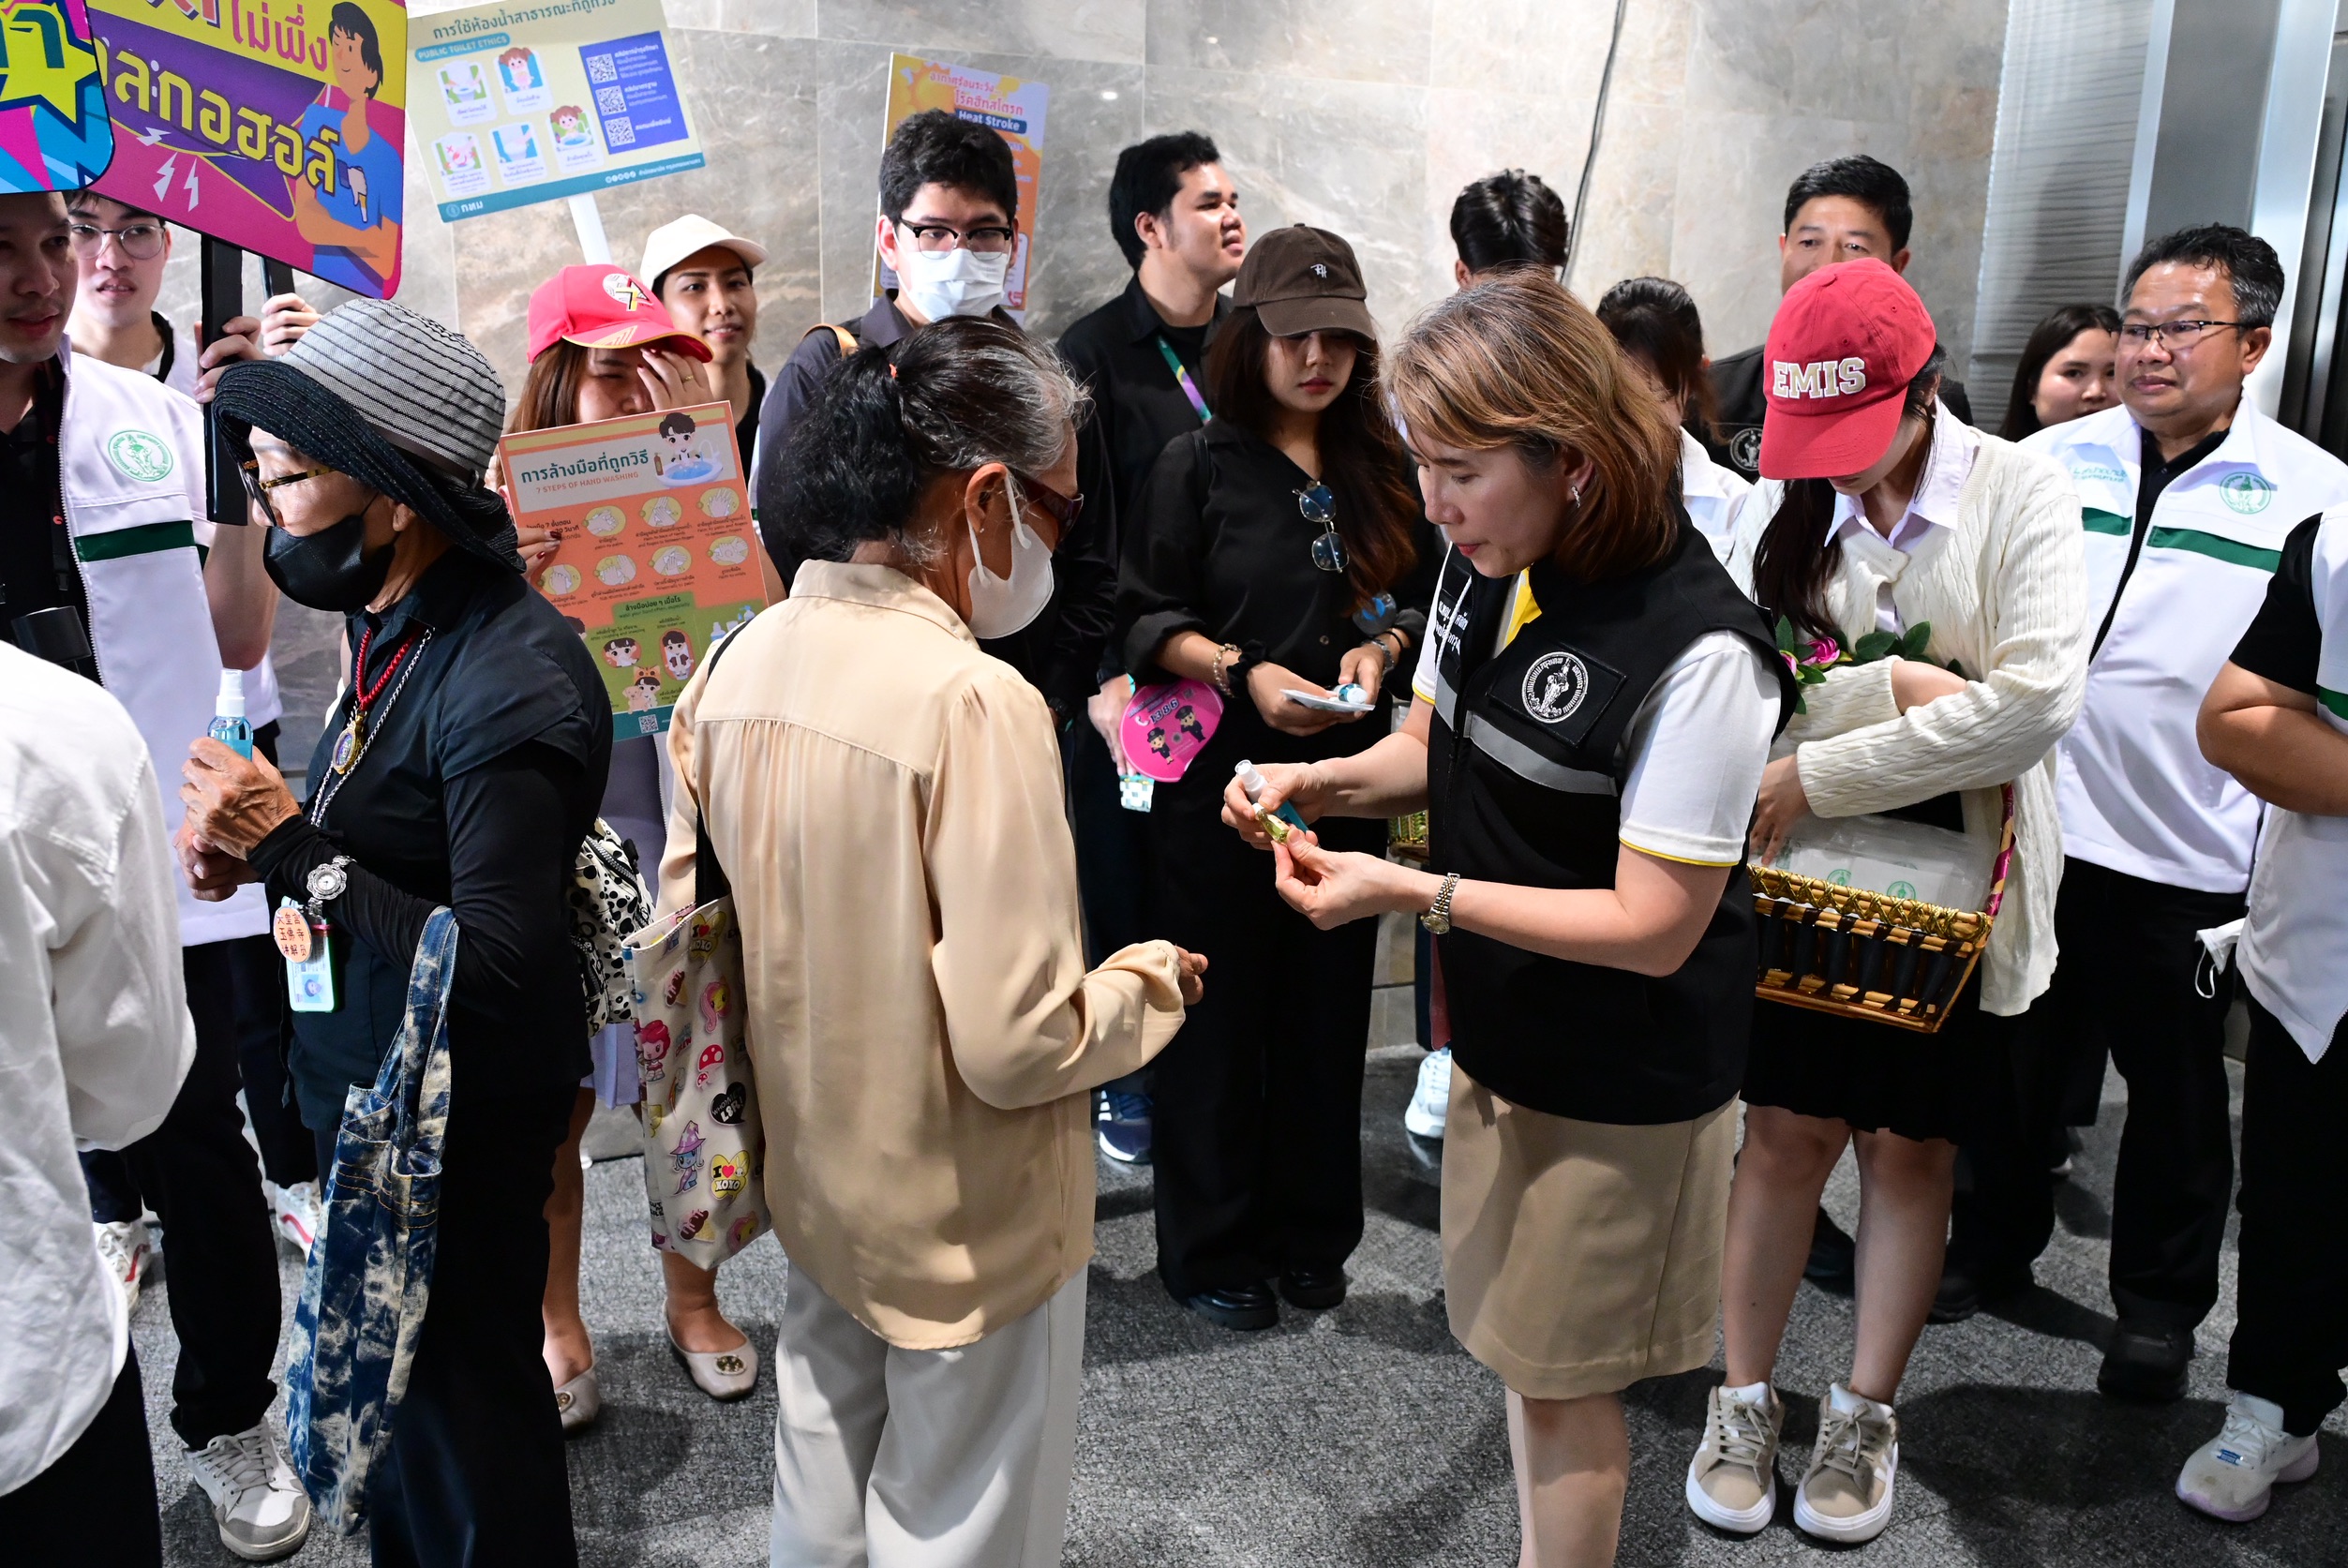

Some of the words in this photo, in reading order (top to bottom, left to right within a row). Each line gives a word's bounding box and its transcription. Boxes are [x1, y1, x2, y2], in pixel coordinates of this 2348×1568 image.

[418, 47, 448, 58] PUBLIC
[450, 41, 476, 52] TOILET
[478, 36, 507, 48] ETHICS
[958, 111, 983, 124] Heat
[985, 115, 1020, 131] Stroke
[460, 201, 484, 213] กทม
[1772, 356, 1866, 399] EMIS
[521, 449, 649, 483] การล้างมือที่ถูกวิธี
[543, 484, 567, 493] STEPS
[579, 478, 602, 487] HAND
[603, 471, 639, 483] WASHING
[1149, 697, 1180, 724] 1386
[712, 1165, 723, 1179] I
[715, 1179, 740, 1192] XOXO
